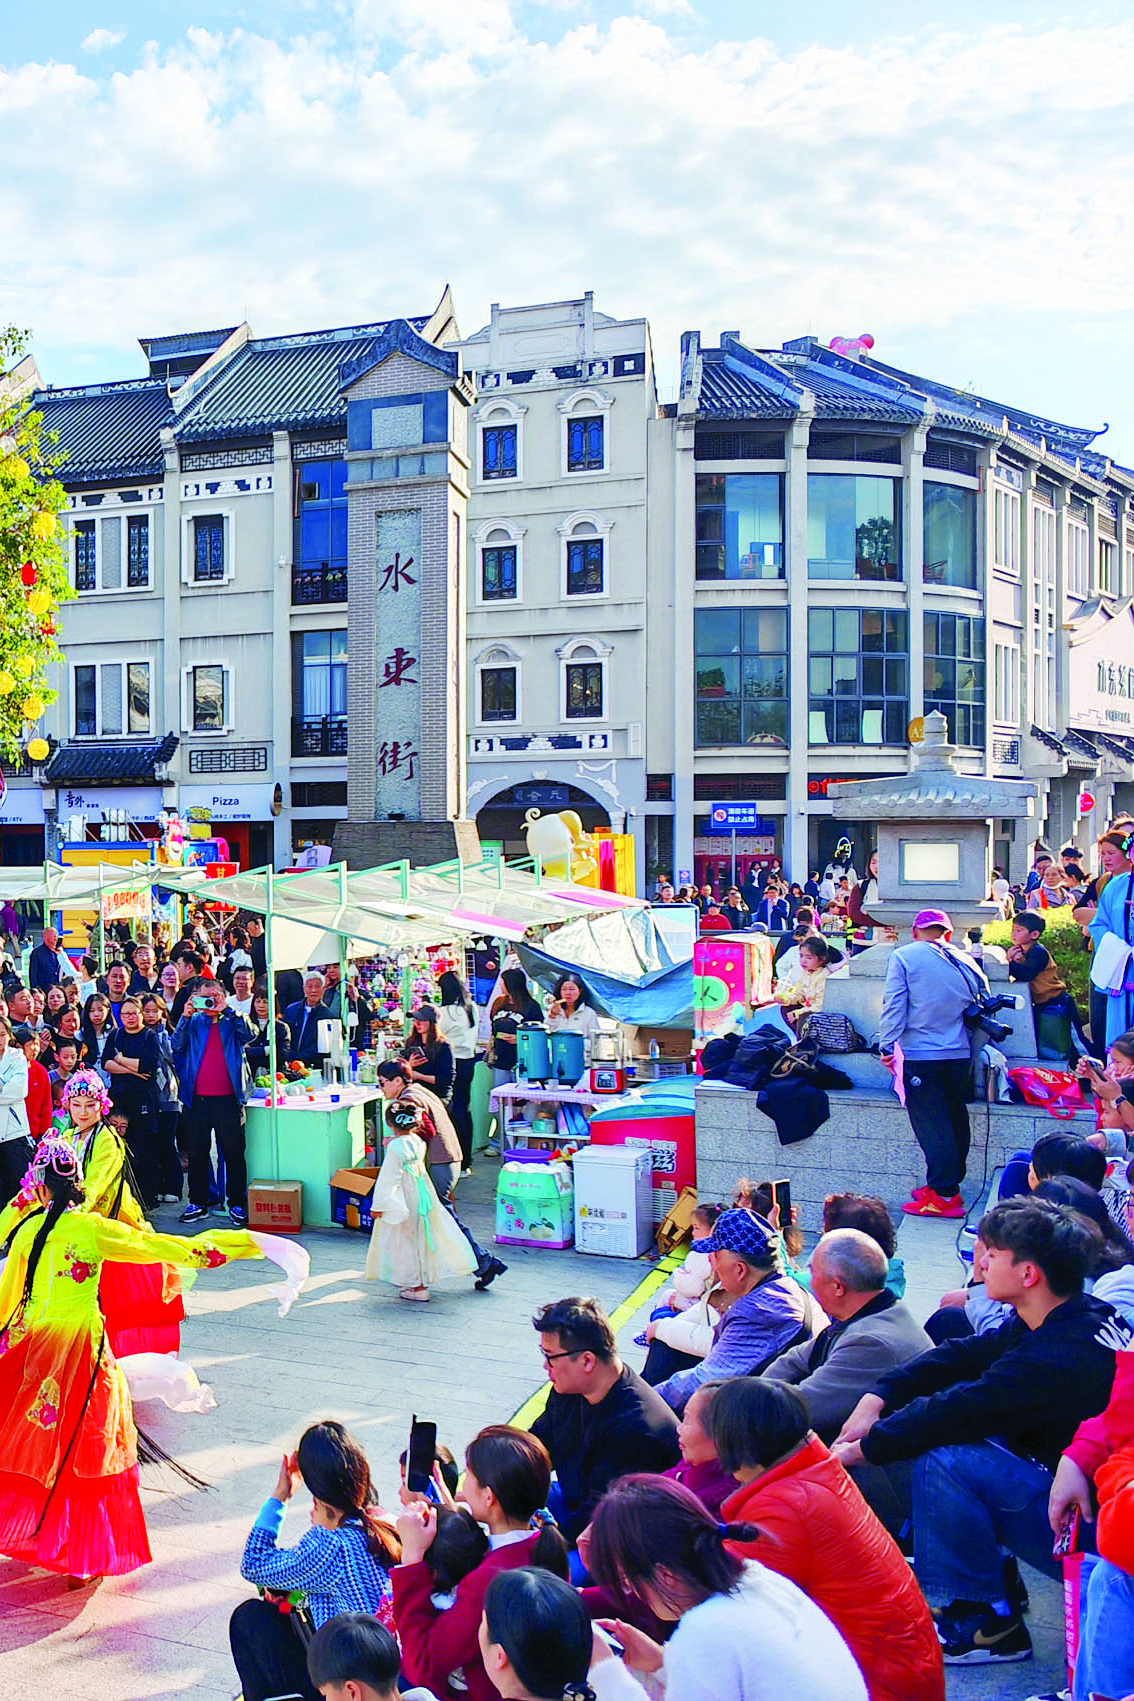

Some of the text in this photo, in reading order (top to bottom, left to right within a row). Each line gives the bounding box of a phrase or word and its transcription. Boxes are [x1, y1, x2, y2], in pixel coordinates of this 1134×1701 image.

[377, 552, 419, 781] 水東街
[212, 796, 240, 806] Pizza
